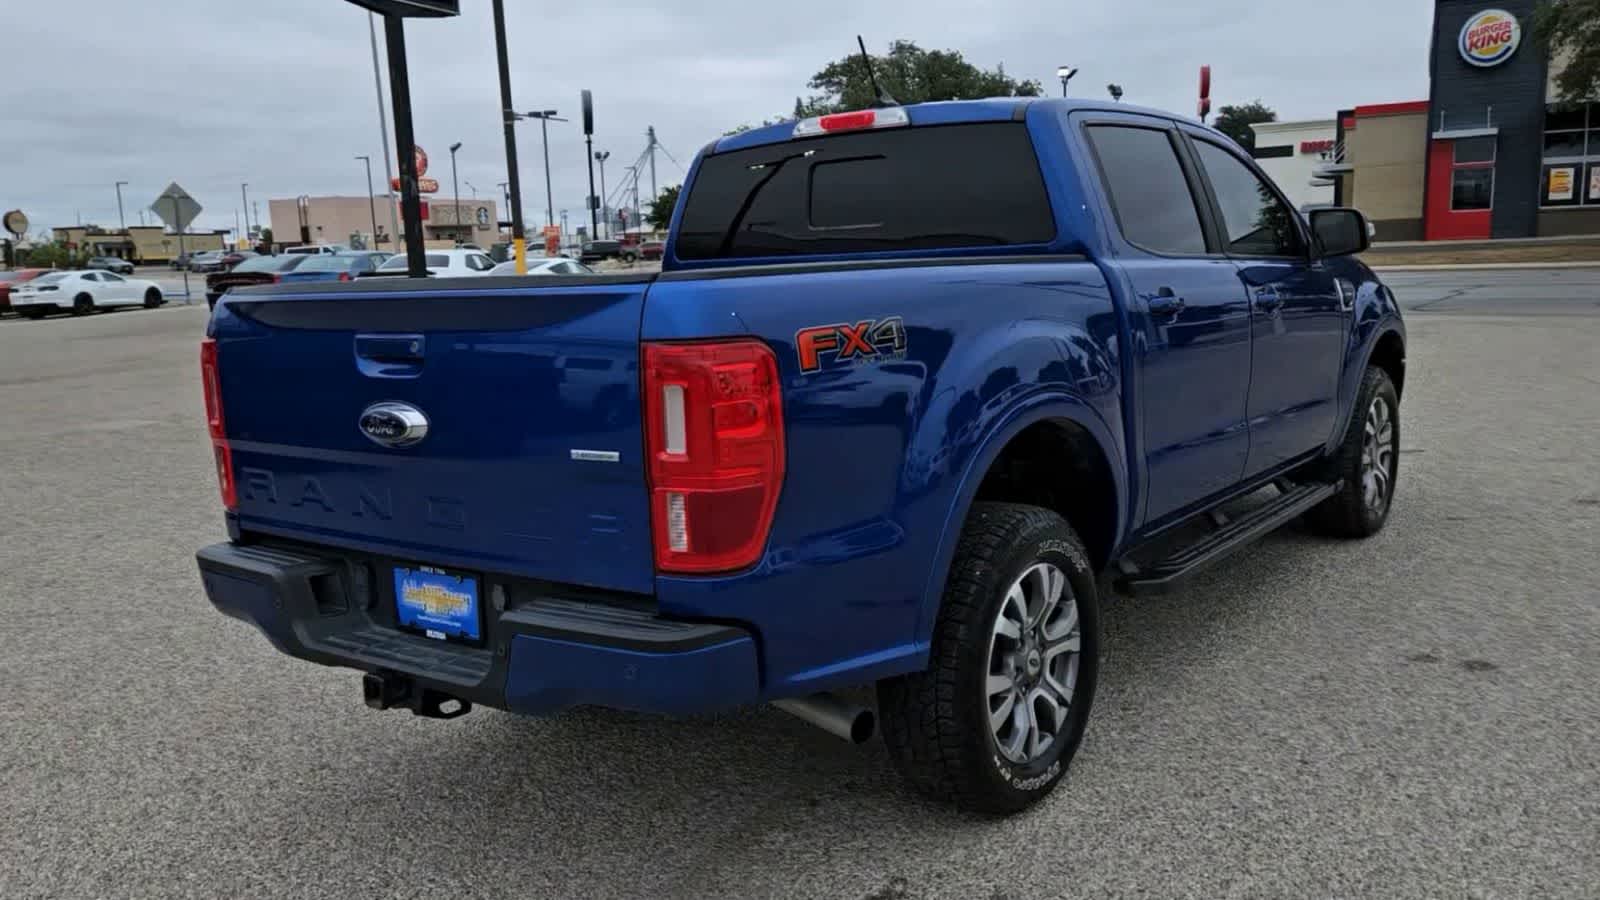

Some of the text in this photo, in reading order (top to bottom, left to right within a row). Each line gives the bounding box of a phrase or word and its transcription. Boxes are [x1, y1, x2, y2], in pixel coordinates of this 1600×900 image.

[1467, 21, 1512, 40] BURGER
[1468, 30, 1512, 52] KING
[795, 316, 907, 375] FX4
[243, 468, 629, 546] RANG
